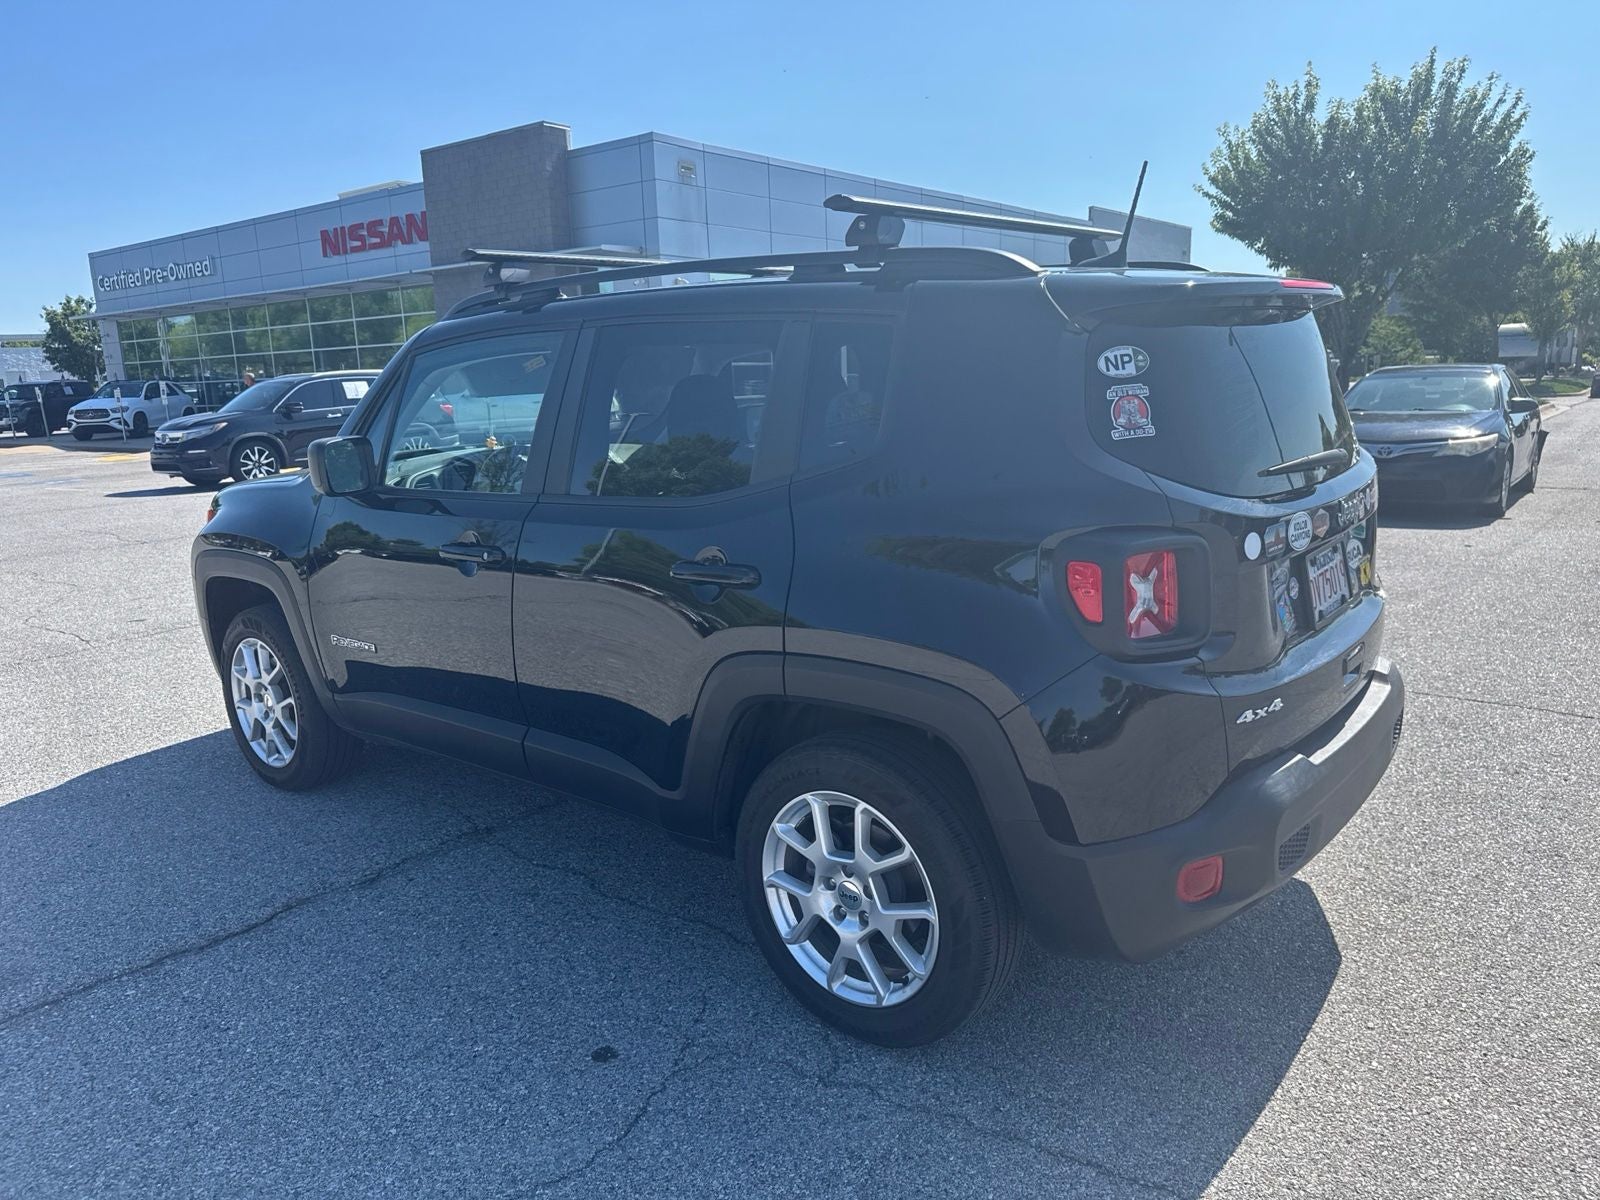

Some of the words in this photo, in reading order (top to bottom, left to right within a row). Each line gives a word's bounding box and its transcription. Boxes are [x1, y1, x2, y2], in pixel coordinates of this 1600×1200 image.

[320, 211, 428, 258] NISSAN
[97, 264, 142, 292] Certified
[144, 255, 213, 285] Pre-Owned
[1104, 353, 1133, 373] NP
[1236, 697, 1284, 724] 4x4
[840, 890, 859, 902] Jeep
